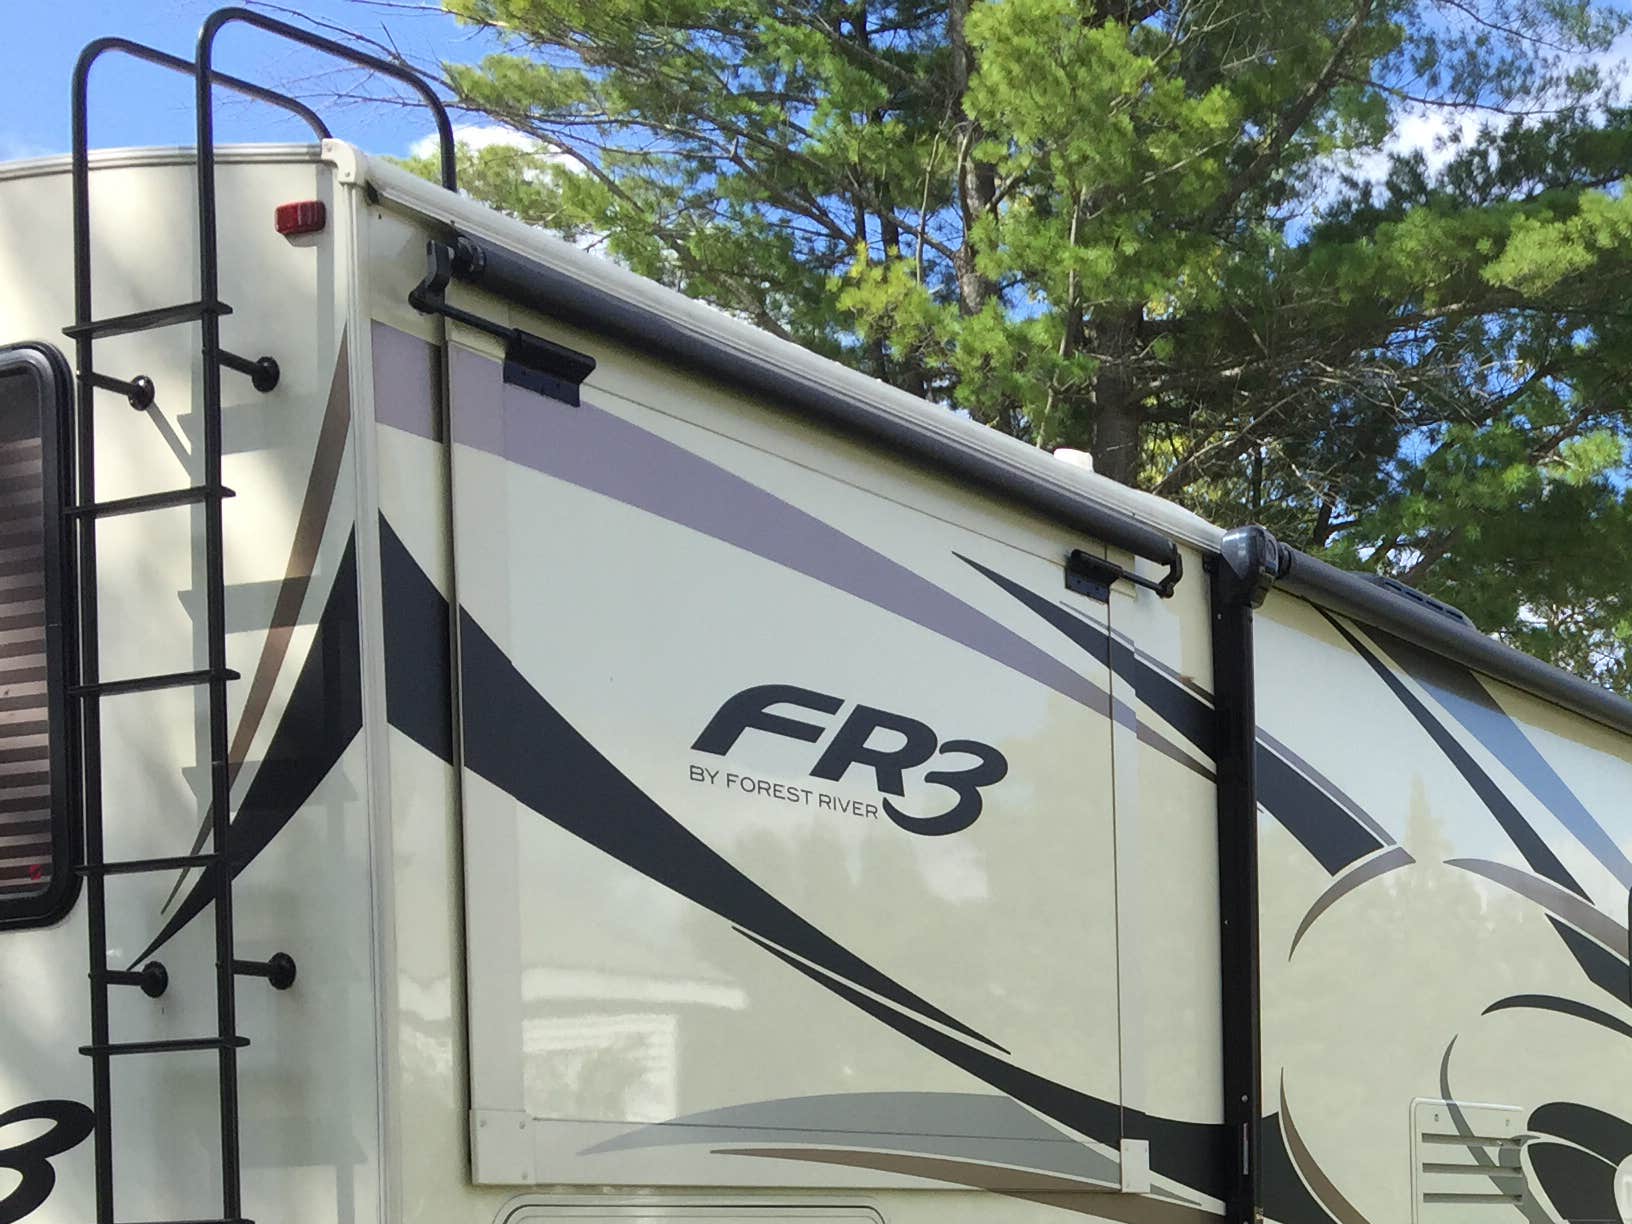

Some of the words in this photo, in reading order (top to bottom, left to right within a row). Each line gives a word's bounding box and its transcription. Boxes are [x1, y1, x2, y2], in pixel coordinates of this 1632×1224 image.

[689, 764, 720, 785] BY
[726, 773, 813, 806] FOREST
[818, 793, 879, 820] RIVER
[690, 684, 1008, 836] FR3
